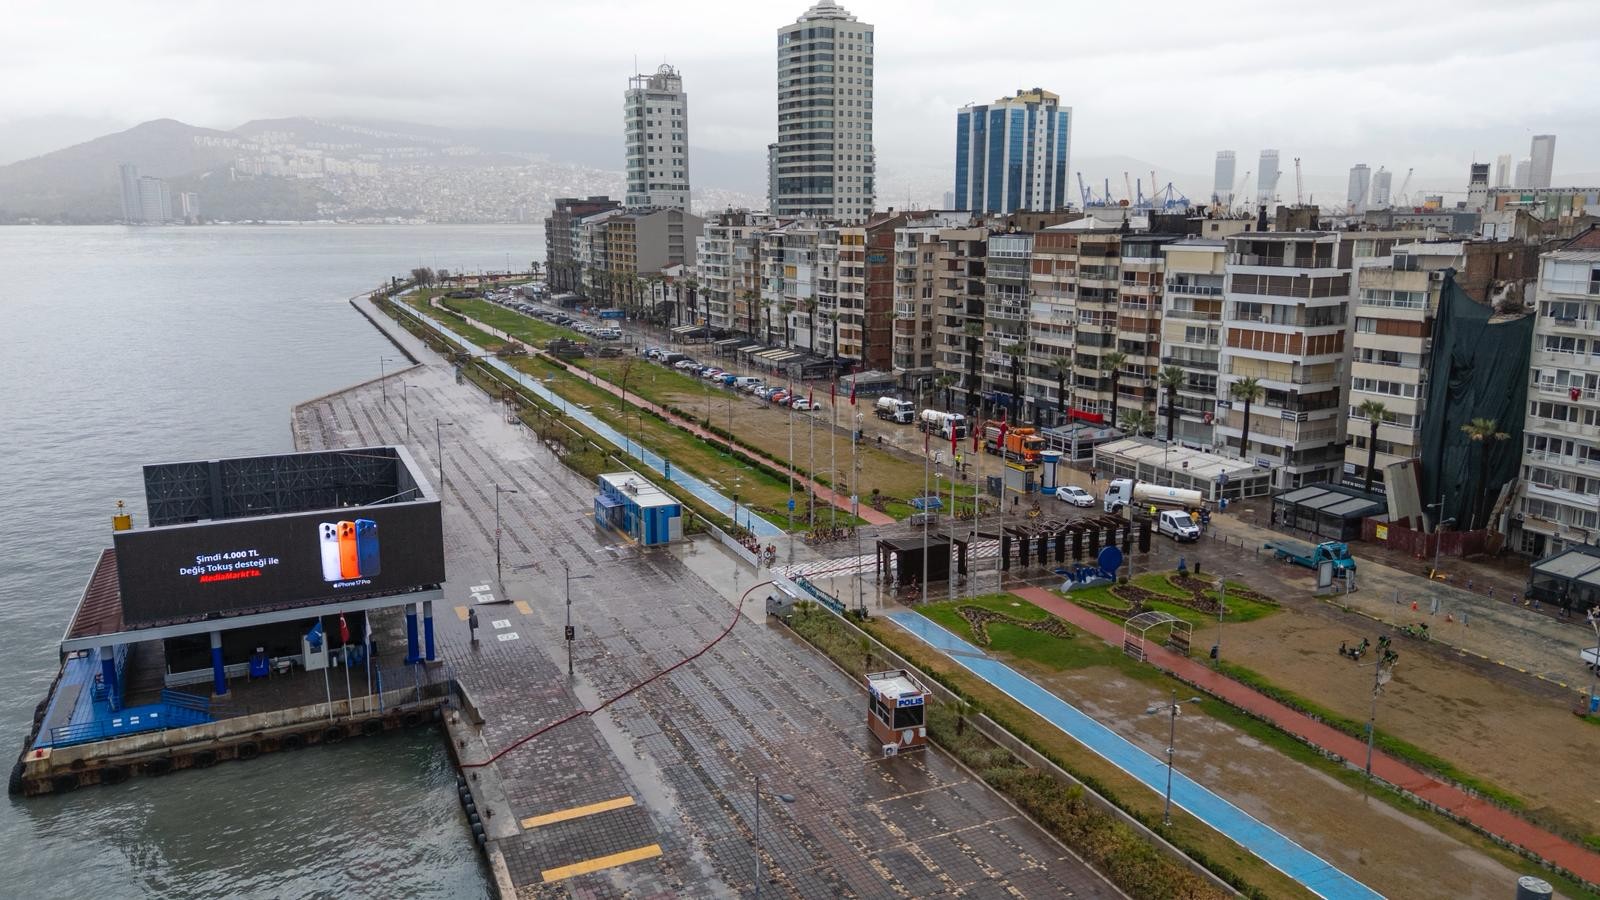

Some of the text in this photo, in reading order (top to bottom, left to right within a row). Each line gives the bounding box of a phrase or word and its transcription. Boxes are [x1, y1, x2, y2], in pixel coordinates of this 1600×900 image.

[196, 549, 259, 564] Şimdi 4.000 TL
[179, 557, 279, 575] Değiş Tokuş desteği ile
